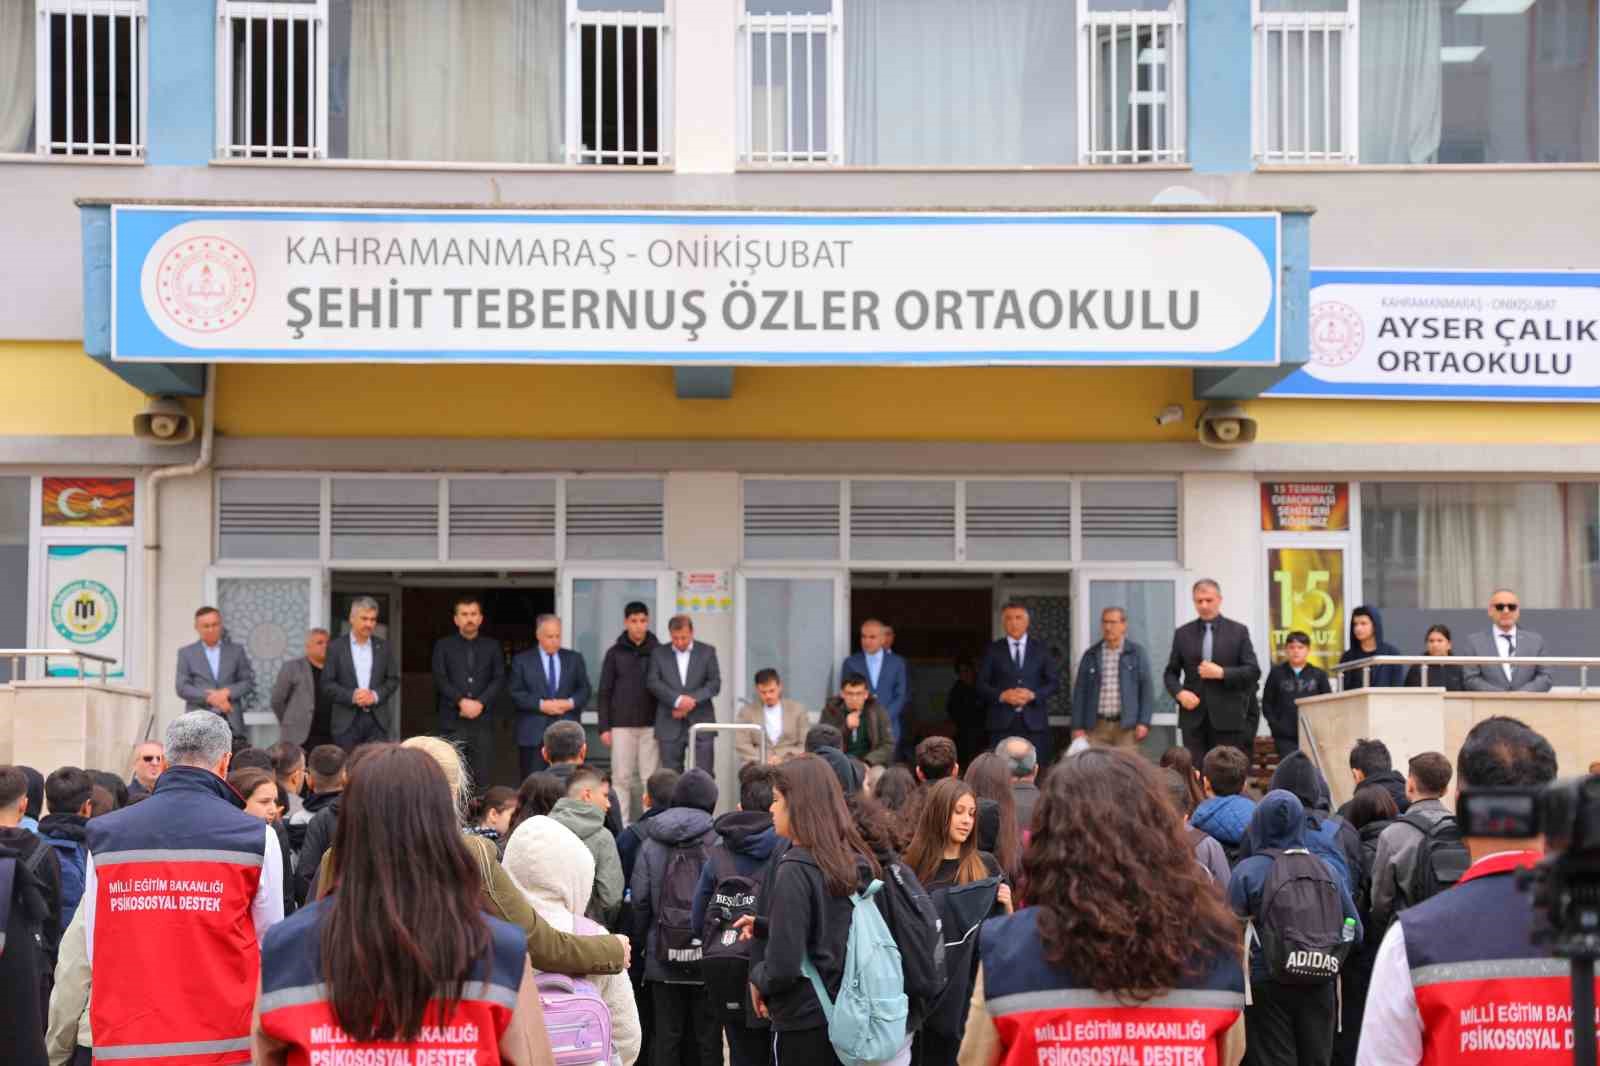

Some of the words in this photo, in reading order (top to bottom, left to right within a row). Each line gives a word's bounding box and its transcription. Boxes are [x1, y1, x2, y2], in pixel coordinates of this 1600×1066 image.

[287, 236, 616, 274] KAHRAMANMARAŞ
[648, 234, 853, 275] ONİKİŞUBAT
[286, 277, 432, 340] ŞEHİT
[443, 288, 707, 342] TEBERNUŞ
[722, 279, 881, 331] ÖZLER
[895, 288, 1199, 331] ORTAOKULU
[1378, 317, 1484, 340] AYSER
[1495, 319, 1598, 347] ÇALIK
[1378, 350, 1572, 375] ORTAOKULU
[1273, 570, 1336, 629] 15
[134, 877, 168, 892] EĞİTİM
[170, 879, 224, 894] BAKANLIĞI
[110, 894, 178, 912] PSİKOSOSYAL
[179, 896, 221, 912] DESTEK
[1286, 951, 1340, 973] ADIDAS
[1498, 1001, 1542, 1023] EĞİTİM
[1075, 1019, 1122, 1041] EĞİTİM
[1125, 1019, 1206, 1040] BAKANLIĞI
[1460, 1025, 1560, 1053] PSİKOSOSYAL
[310, 1045, 411, 1066] PSİKOSOSYAL
[416, 1048, 478, 1066] DESTEK
[1037, 1042, 1139, 1066] PSİKOSOSYAL
[1143, 1046, 1206, 1066] DESTEK
